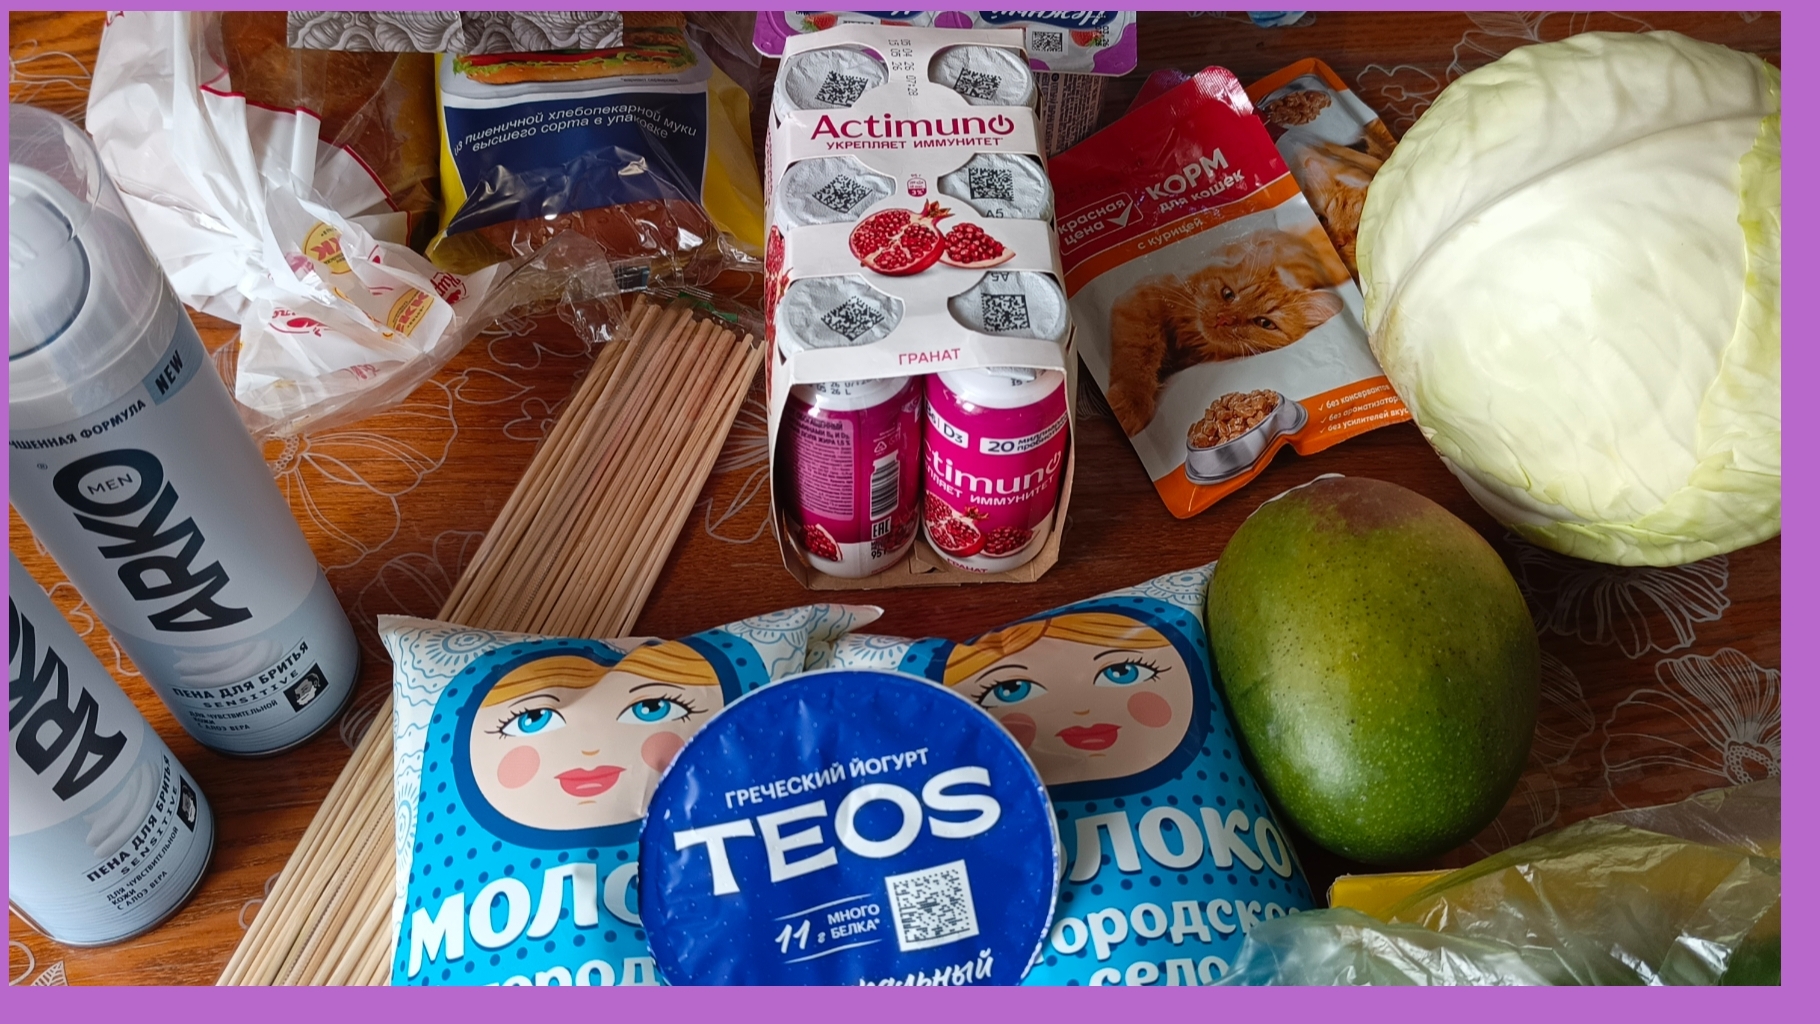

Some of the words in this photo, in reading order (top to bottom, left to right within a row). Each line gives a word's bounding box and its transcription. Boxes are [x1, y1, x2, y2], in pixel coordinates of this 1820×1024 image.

[465, 112, 544, 146] пшеничной
[548, 104, 662, 125] хлебопекарной
[663, 118, 698, 138] муки
[472, 125, 537, 153] высшего
[540, 117, 590, 135] сорта
[593, 116, 603, 125] в
[606, 113, 669, 139] упаковке
[826, 140, 907, 150] УКРЕПЛЯЕТ
[1144, 147, 1229, 201] КОРМ
[1158, 196, 1188, 214] для
[1191, 169, 1245, 201] кошек
[1057, 198, 1127, 236] красная
[1063, 219, 1105, 246] цена
[1148, 217, 1204, 246] курицей
[154, 350, 184, 396] NEW
[898, 348, 961, 365] ГРАНАТ
[1326, 398, 1340, 410] без
[1327, 421, 1342, 432] без
[1342, 411, 1390, 430] усилителей
[1328, 410, 1342, 422] без
[1343, 395, 1401, 416] ароматизатор
[9, 433, 78, 450] ЧШЕННАЯ
[80, 399, 147, 440] ФОРМУЛА
[943, 423, 964, 444] D3
[987, 440, 1015, 453] 20
[86, 473, 134, 495] MEN
[925, 462, 964, 498] ПЛЯЕТ
[970, 474, 1056, 506] ИММУНИТЕТ
[52, 448, 254, 633] ARKO
[172, 687, 215, 699] ПЕНА
[218, 680, 256, 699] ДЛЯ
[258, 641, 309, 685] БРИТЬЯ
[202, 669, 299, 709] SENSITIVE
[9, 594, 128, 802] ARK
[206, 699, 278, 720] ЧУВСТВИТЕЛЬНОЙ
[724, 763, 846, 810] ГРЕЧЕСКИЙ
[849, 747, 931, 779] ЙОГУРТ
[86, 850, 131, 883] ПЕНА
[131, 814, 158, 851] ДЛЯ
[155, 754, 171, 813] БРИТЬЯ
[120, 786, 178, 876] SENSITIVE
[672, 765, 1002, 897] TEOS
[106, 887, 126, 902] ДЛЯ
[126, 825, 179, 888] ЧУВСТВИТЕЛЬНОЙ
[1059, 806, 1293, 883] ЛОКО
[111, 888, 137, 906] КОЖИ
[126, 887, 149, 907] АЛОЭ
[149, 870, 168, 890] ВЕРА
[826, 903, 880, 926] МНОГО
[774, 919, 812, 954] 11
